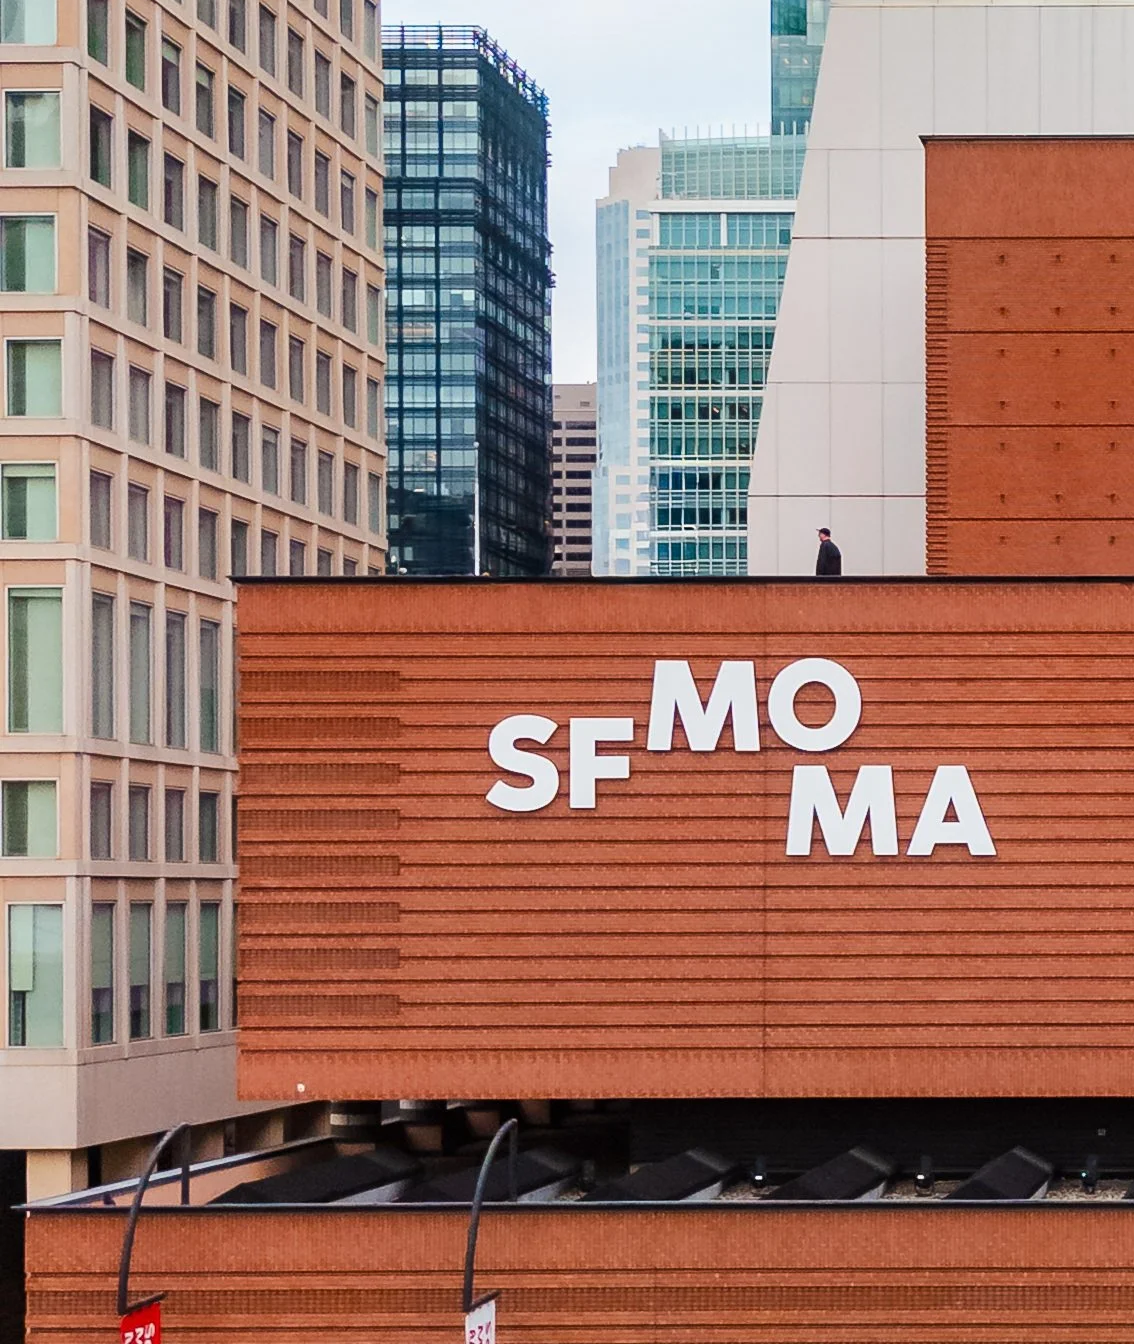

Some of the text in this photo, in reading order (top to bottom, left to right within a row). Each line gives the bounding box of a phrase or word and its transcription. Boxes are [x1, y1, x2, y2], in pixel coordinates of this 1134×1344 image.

[647, 658, 862, 752] MO
[486, 714, 634, 812] SF
[785, 765, 997, 856] MA
